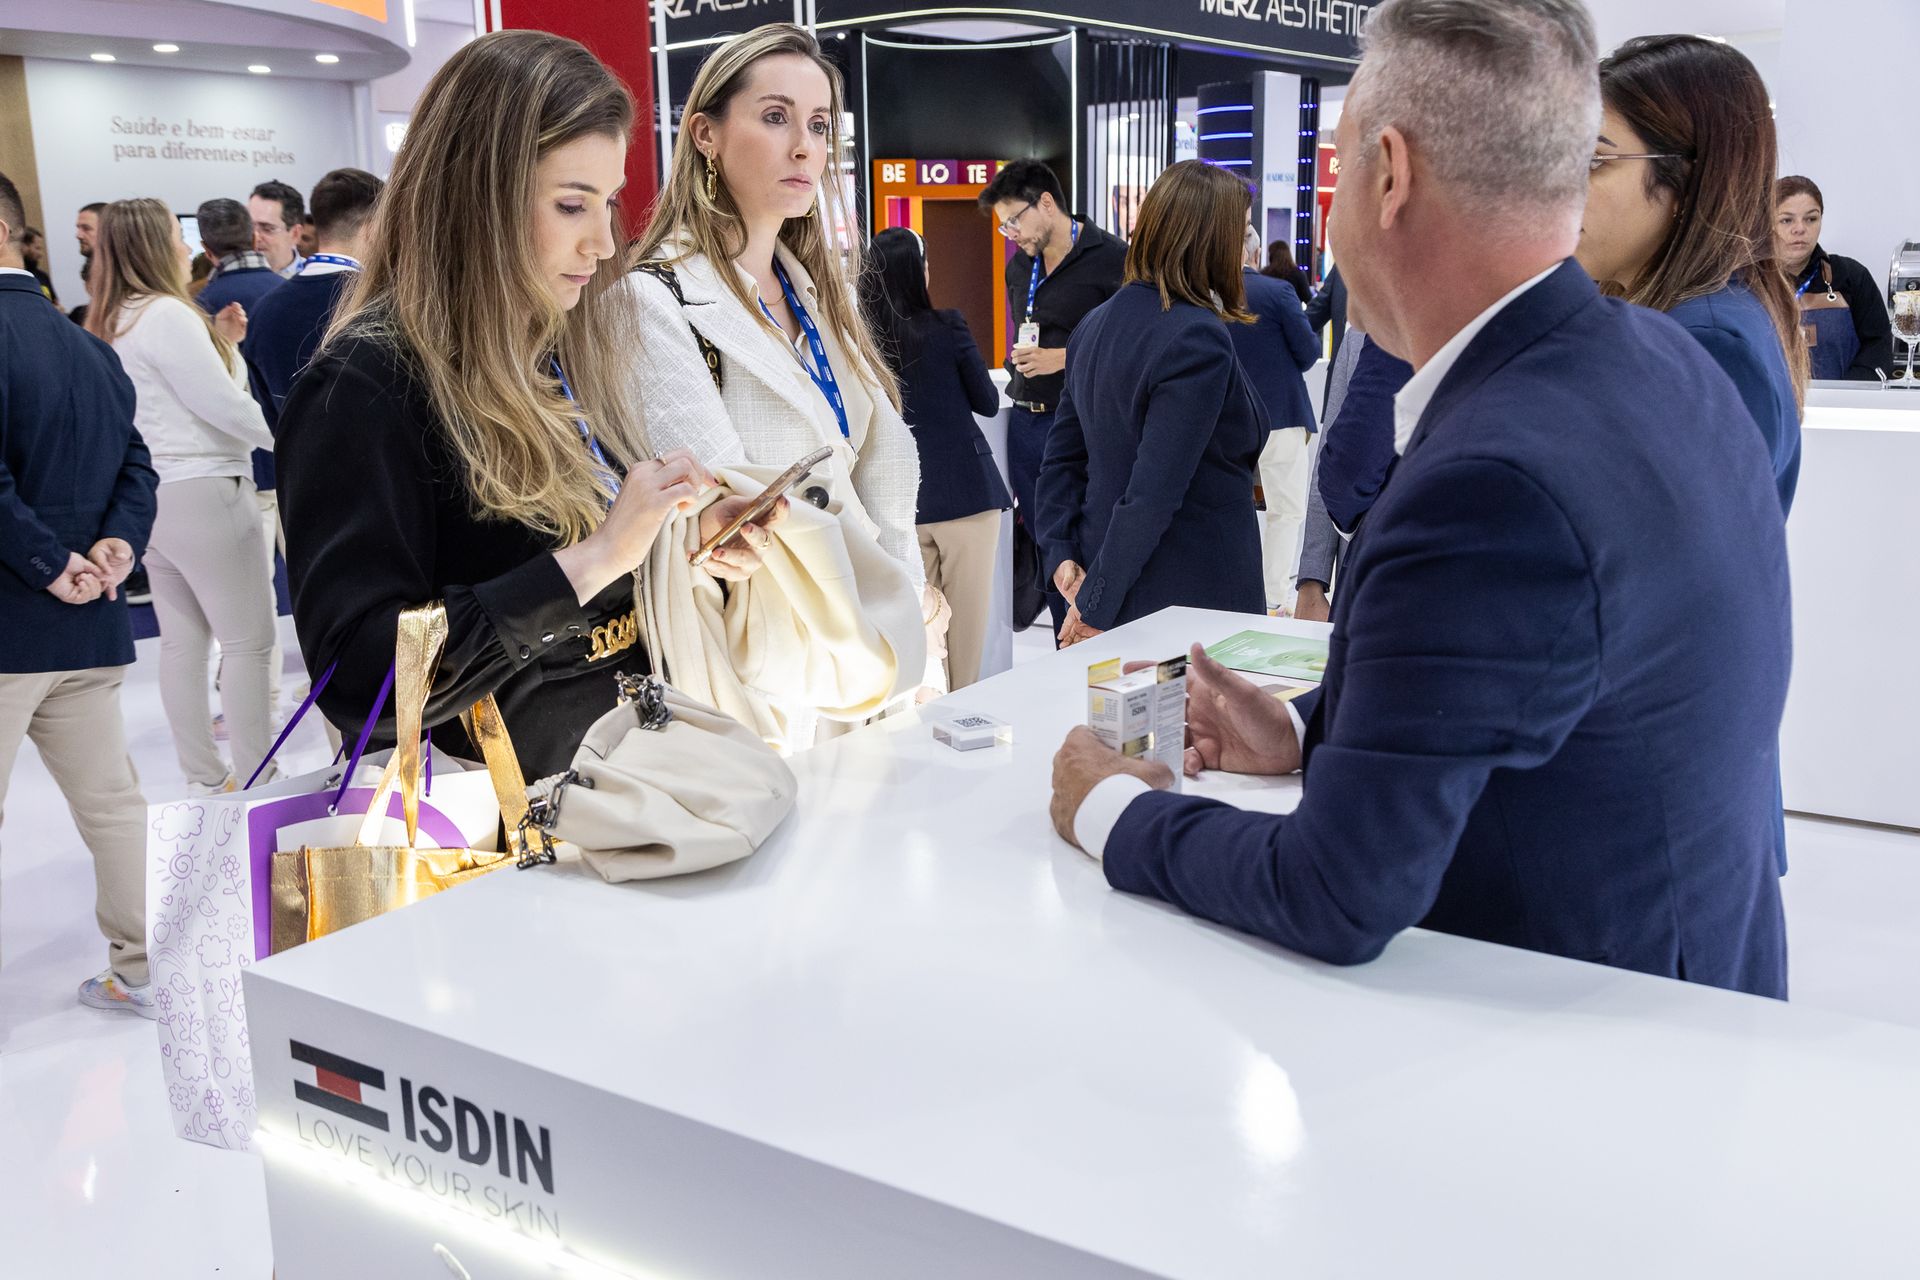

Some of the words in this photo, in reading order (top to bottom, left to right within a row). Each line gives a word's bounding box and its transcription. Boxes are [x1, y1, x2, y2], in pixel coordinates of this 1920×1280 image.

[1265, 0, 1371, 37] AESTHETIC
[110, 115, 167, 137] Saúde
[171, 123, 182, 137] e
[187, 119, 275, 142] bem-estar
[113, 142, 157, 162] para
[161, 140, 248, 163] diferentes
[252, 146, 296, 167] peles
[882, 163, 906, 183] BE
[922, 163, 950, 184] LO
[967, 164, 988, 184] TE
[399, 1076, 555, 1195] ISDIN
[296, 1112, 373, 1167] LOVE
[383, 1143, 472, 1206] YOUR
[484, 1186, 560, 1239] SKIN
